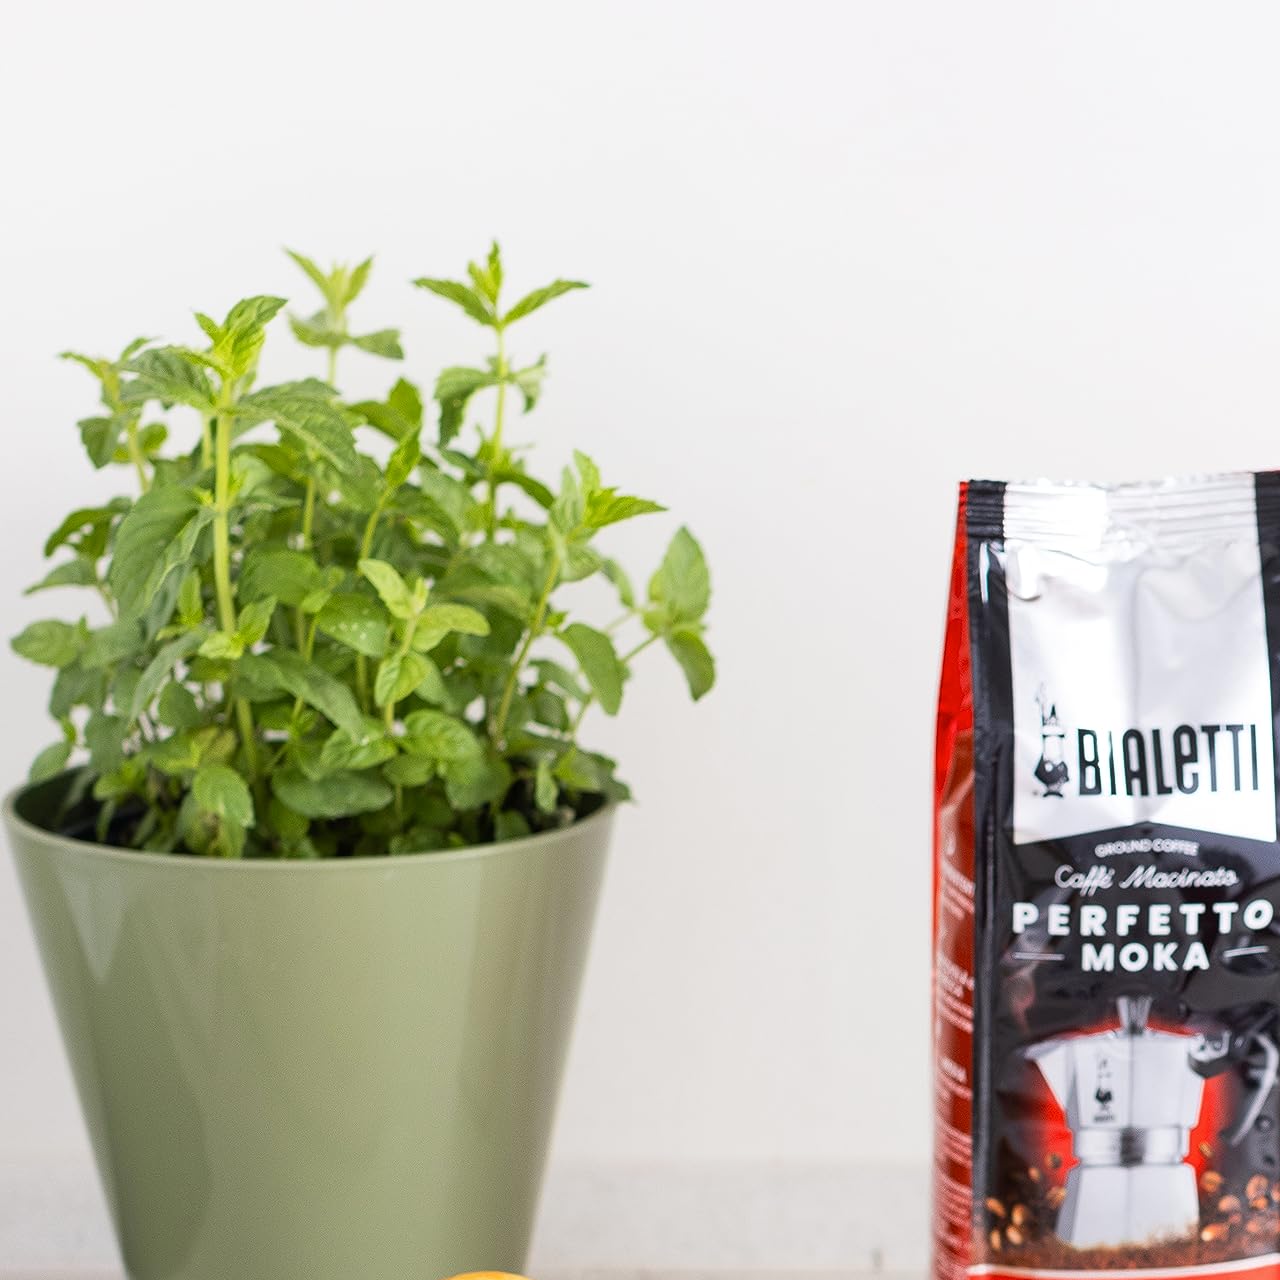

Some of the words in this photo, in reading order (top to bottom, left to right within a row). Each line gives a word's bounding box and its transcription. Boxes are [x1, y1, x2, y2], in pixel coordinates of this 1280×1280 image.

[1119, 865, 1239, 889] Macinato
[1013, 899, 1274, 937] PERFETTO
[1081, 942, 1210, 972] MOKA
